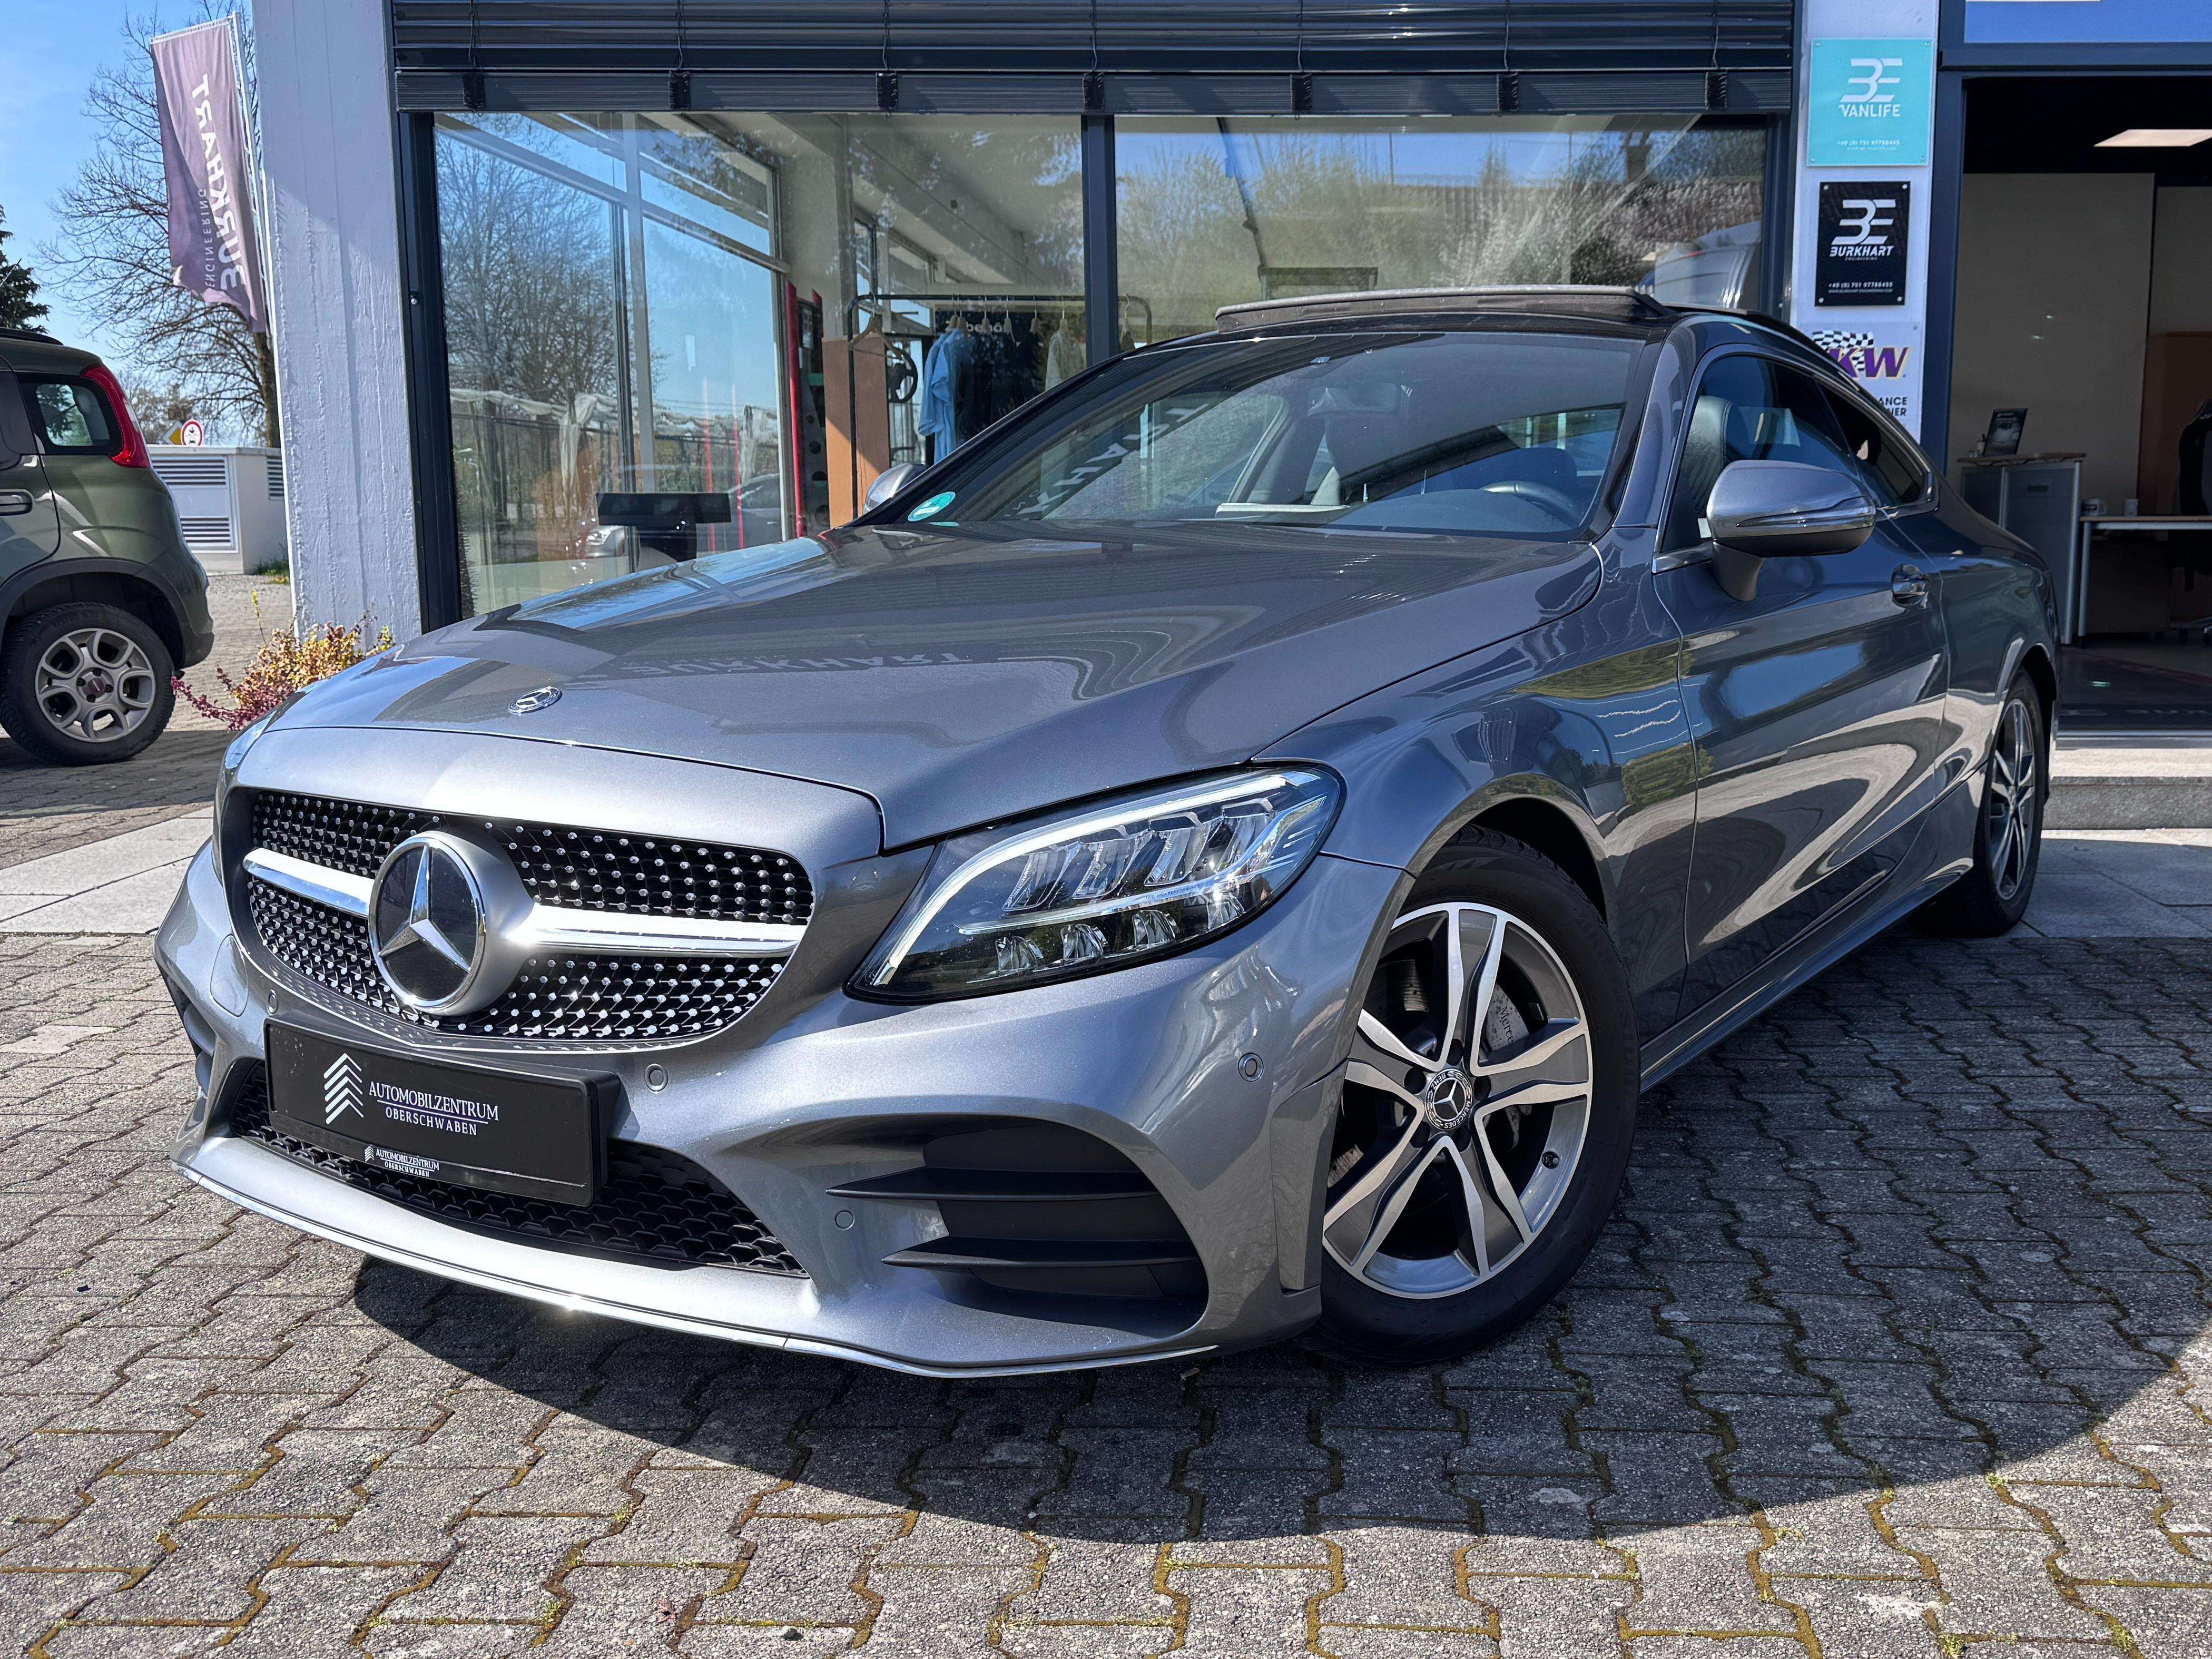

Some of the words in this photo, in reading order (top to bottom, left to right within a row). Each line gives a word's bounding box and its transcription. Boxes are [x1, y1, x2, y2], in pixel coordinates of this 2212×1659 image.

[1838, 104, 1901, 117] VANLIFE
[1830, 246, 1894, 257] BURKHART
[1431, 1072, 1447, 1090] BENZ
[369, 1081, 499, 1121] AUTOMOBILZENTRUM
[385, 1106, 477, 1136] OBERSCHWABEN
[1443, 1100, 1472, 1129] MERCEDES
[376, 1148, 439, 1171] AUTOMOBILZENTRUM
[384, 1161, 430, 1177] OBERSCHWABEN
